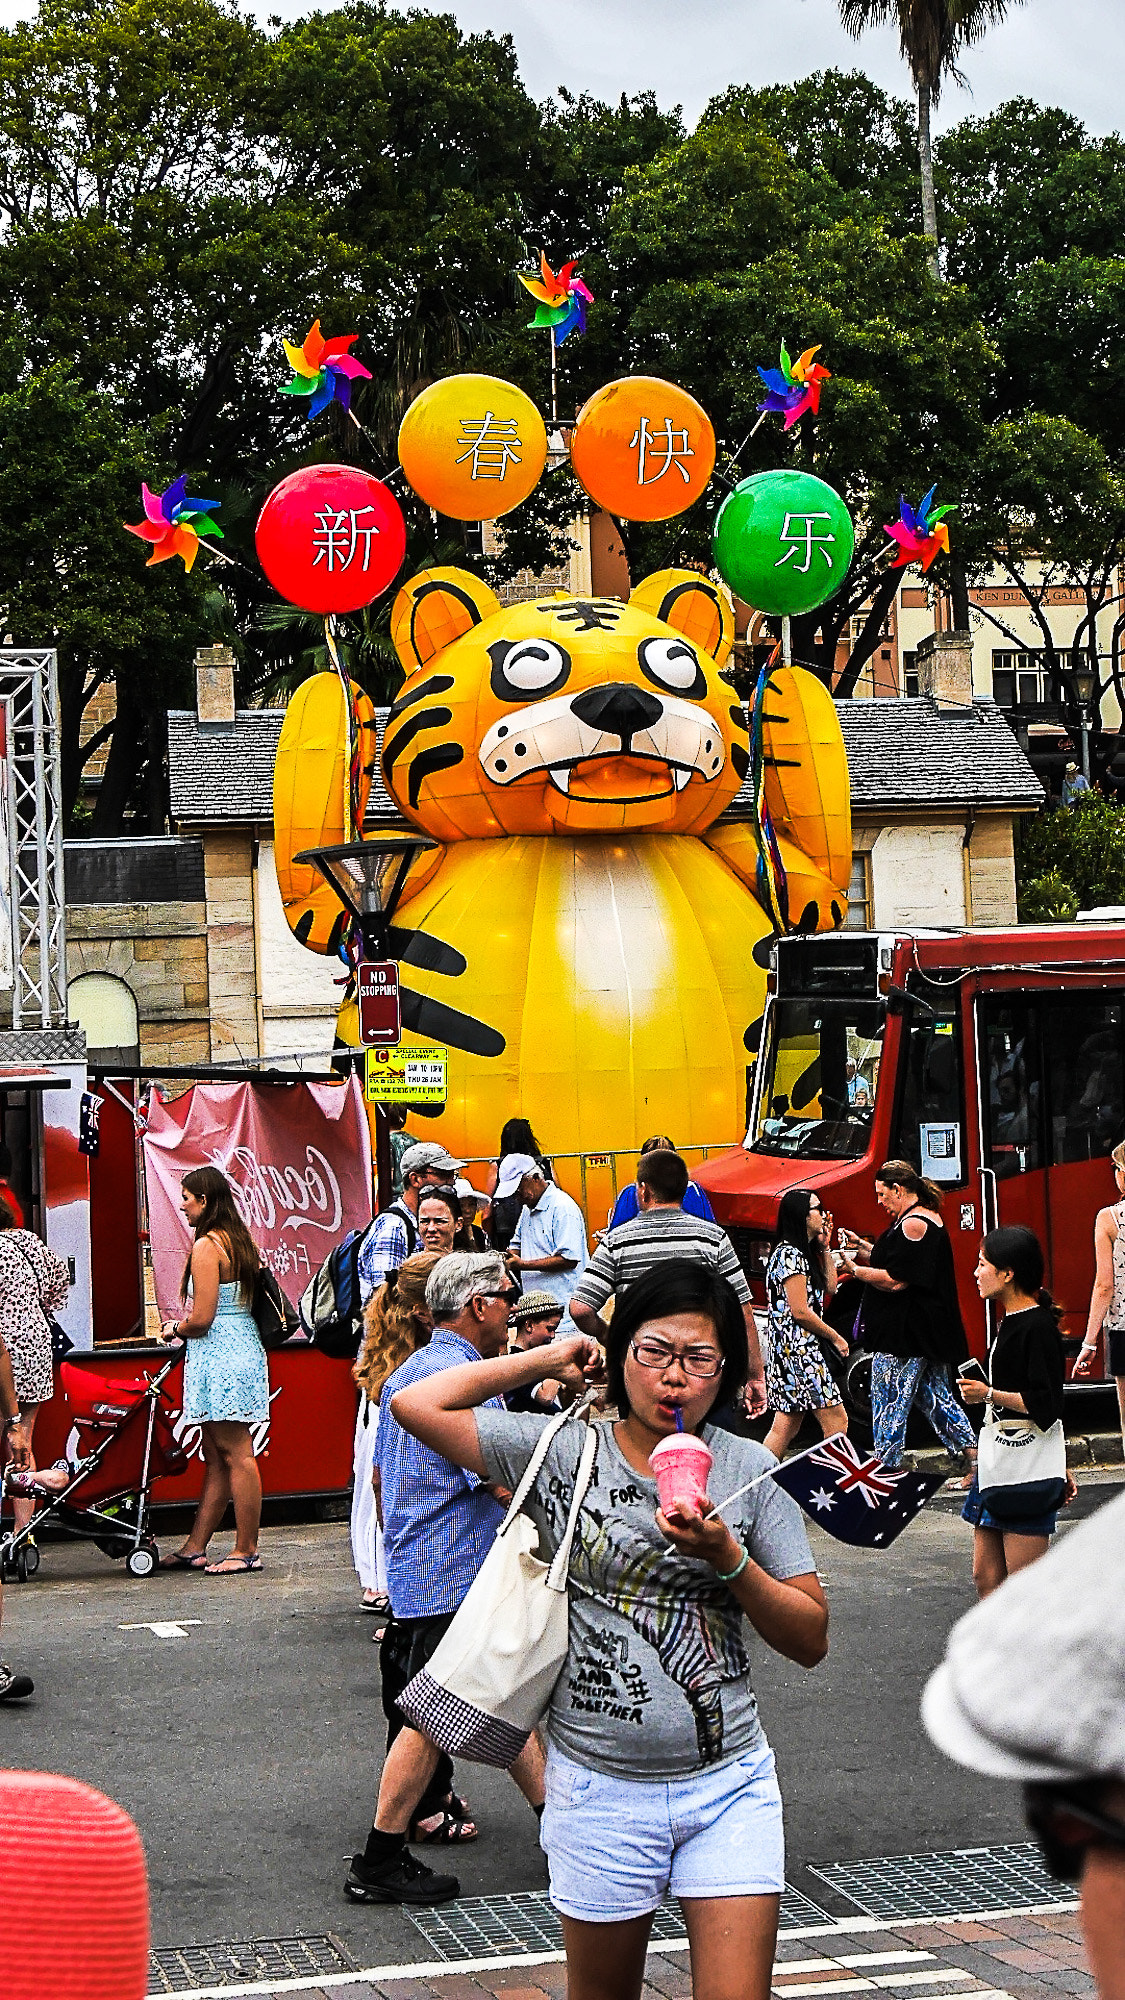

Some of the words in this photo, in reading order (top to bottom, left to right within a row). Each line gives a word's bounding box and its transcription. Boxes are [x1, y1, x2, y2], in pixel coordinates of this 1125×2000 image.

[312, 503, 379, 573] 新
[456, 411, 523, 482] 春
[630, 416, 695, 485] 快
[775, 511, 836, 573] 乐
[976, 592, 999, 601] KEN
[371, 971, 386, 983] NO
[361, 985, 397, 996] STOPPING
[609, 1484, 643, 1508] FOR
[577, 1668, 612, 1687] AND
[571, 1695, 643, 1725] TOGETHER
